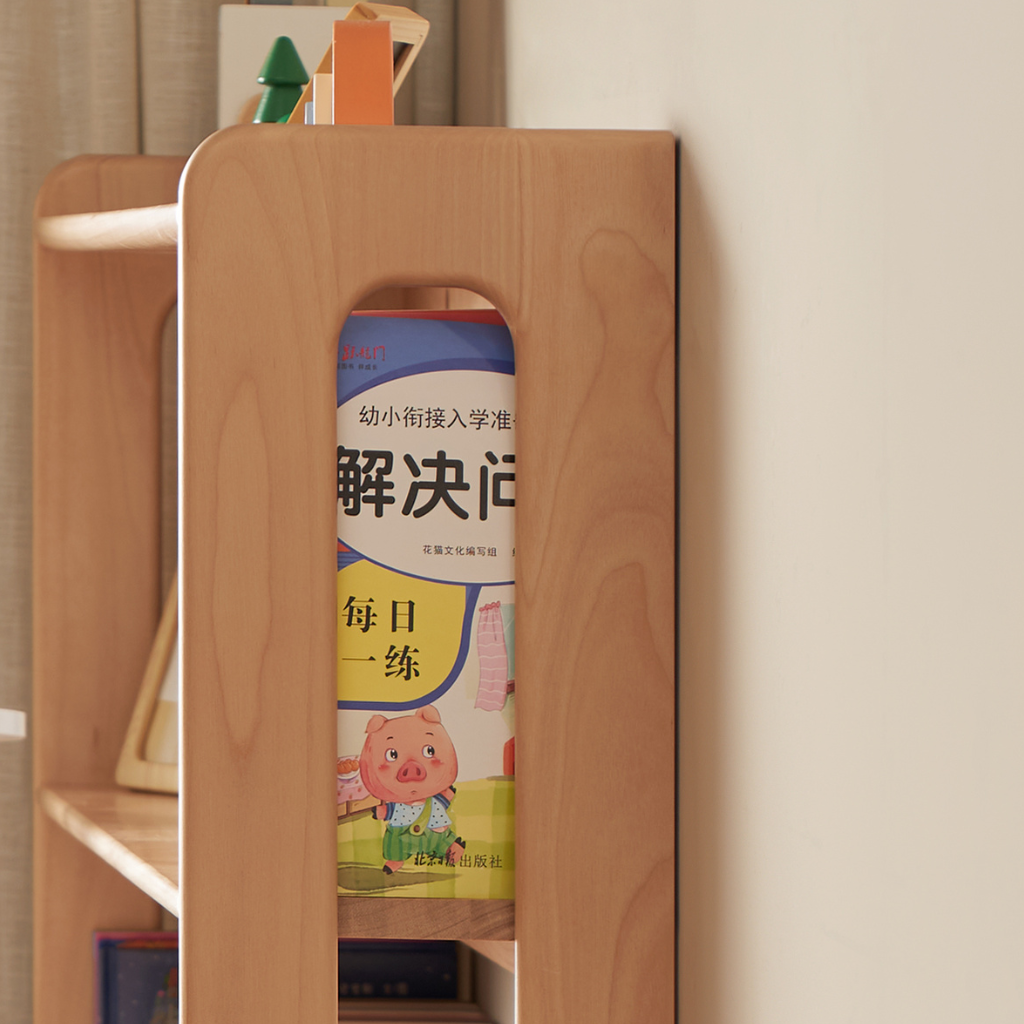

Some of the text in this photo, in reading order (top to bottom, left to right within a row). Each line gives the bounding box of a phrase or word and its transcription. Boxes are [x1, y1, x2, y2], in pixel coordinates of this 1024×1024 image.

[359, 405, 516, 431] 幼小衔接入学准
[422, 544, 497, 557] 花猫文化编写组
[341, 595, 416, 633] 每日
[341, 644, 420, 681] 一练
